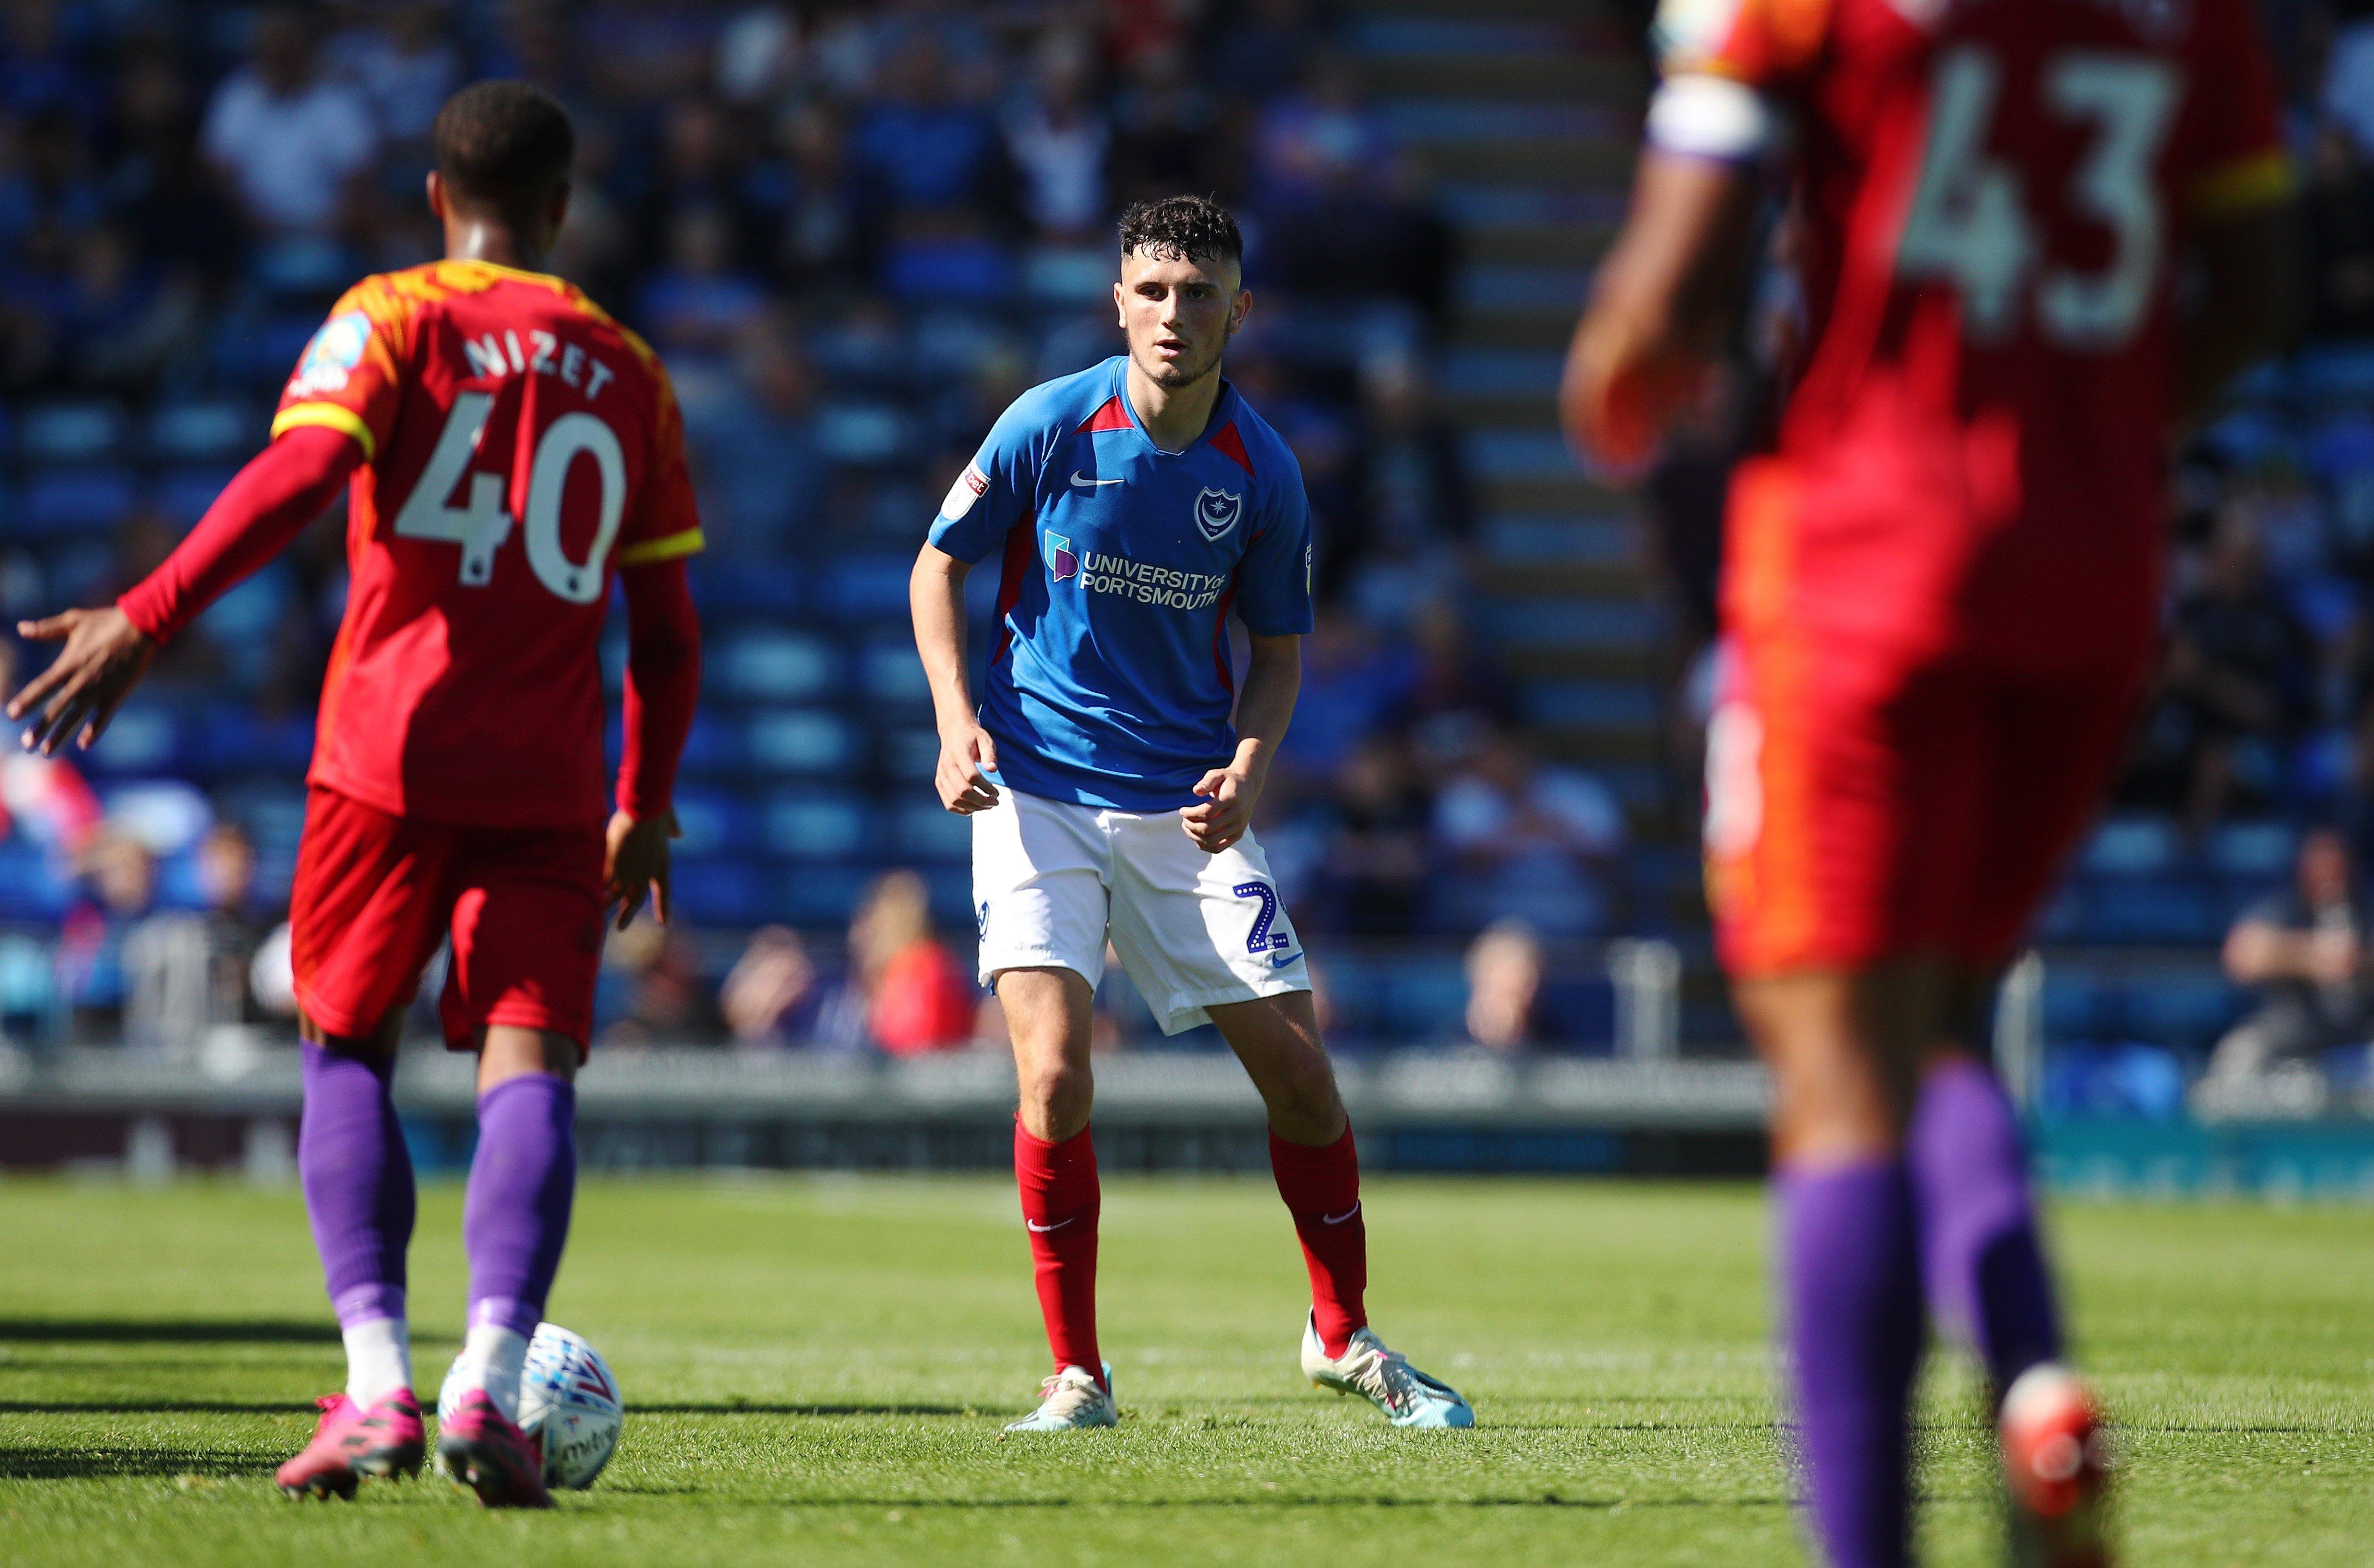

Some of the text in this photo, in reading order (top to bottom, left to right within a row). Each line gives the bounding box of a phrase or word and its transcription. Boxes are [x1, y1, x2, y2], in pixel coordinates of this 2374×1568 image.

[1882, 43, 2181, 348] 43
[463, 329, 615, 401] NIZET
[394, 391, 626, 604] 40
[1079, 571, 1219, 610] PORTSMOUTH
[1083, 551, 1217, 591] UNIVERSITY
[1233, 882, 1289, 953] 2
